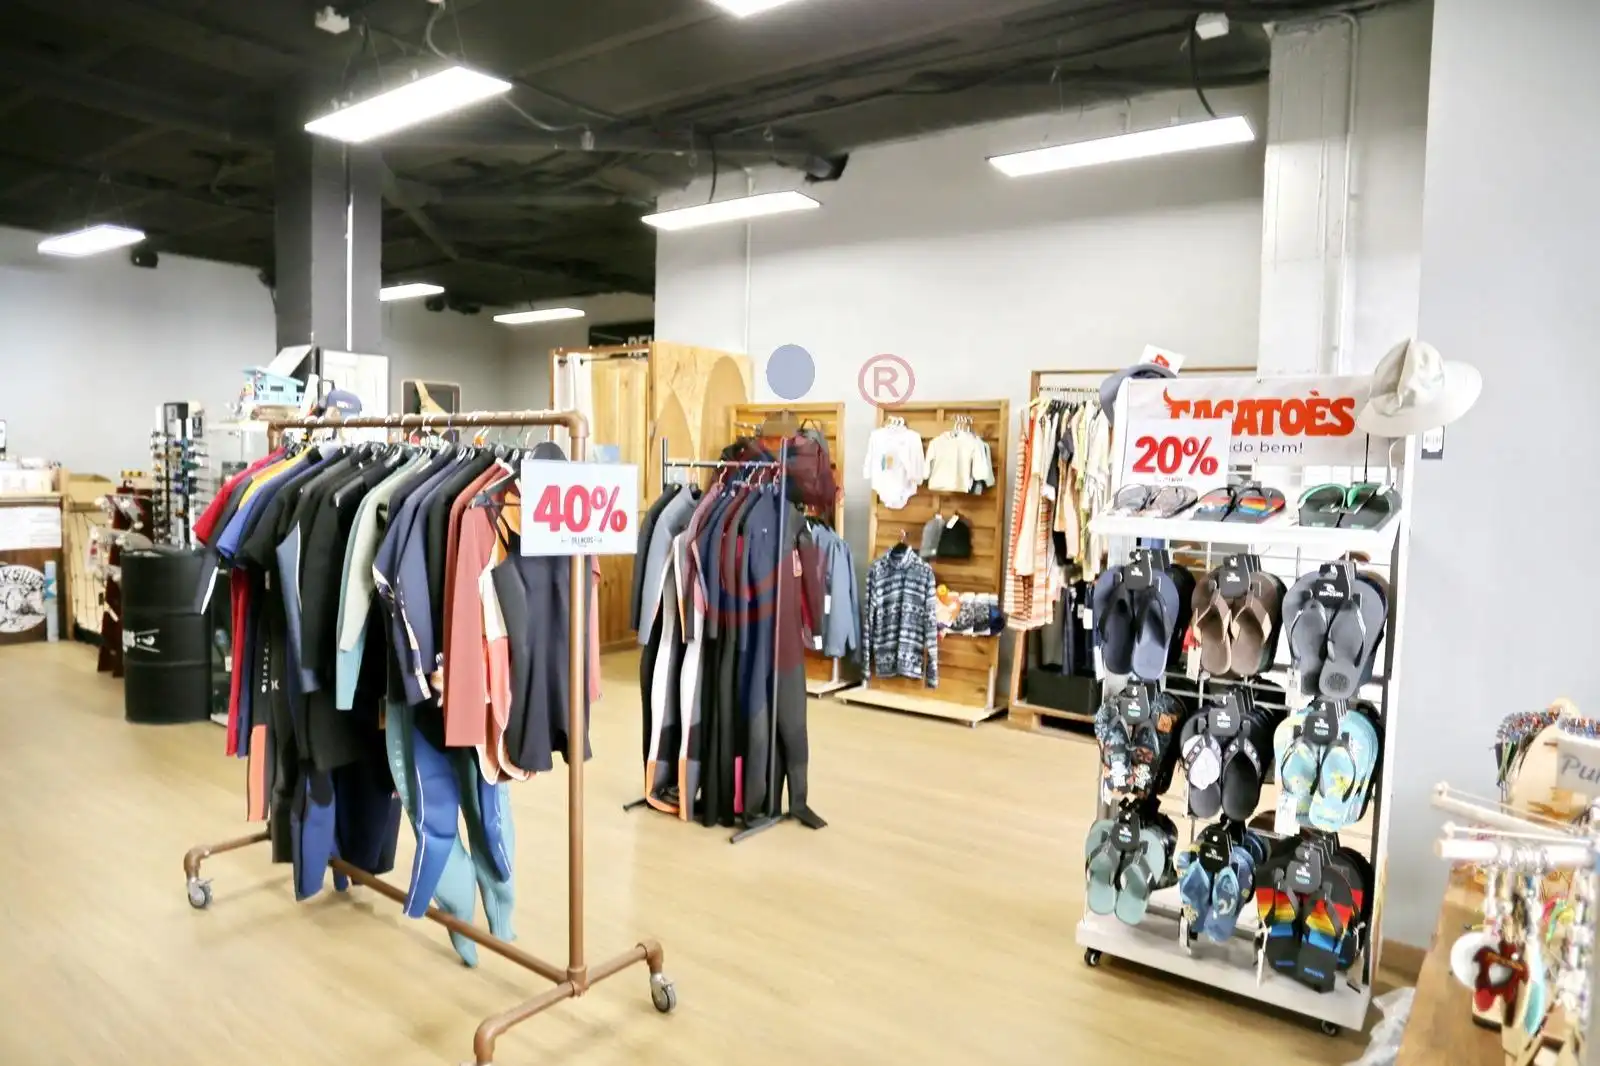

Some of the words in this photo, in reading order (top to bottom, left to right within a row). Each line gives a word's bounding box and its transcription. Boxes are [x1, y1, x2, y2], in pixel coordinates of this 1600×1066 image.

[1132, 435, 1219, 476] 20%
[1260, 441, 1303, 454] bem!
[533, 484, 628, 532] 40%
